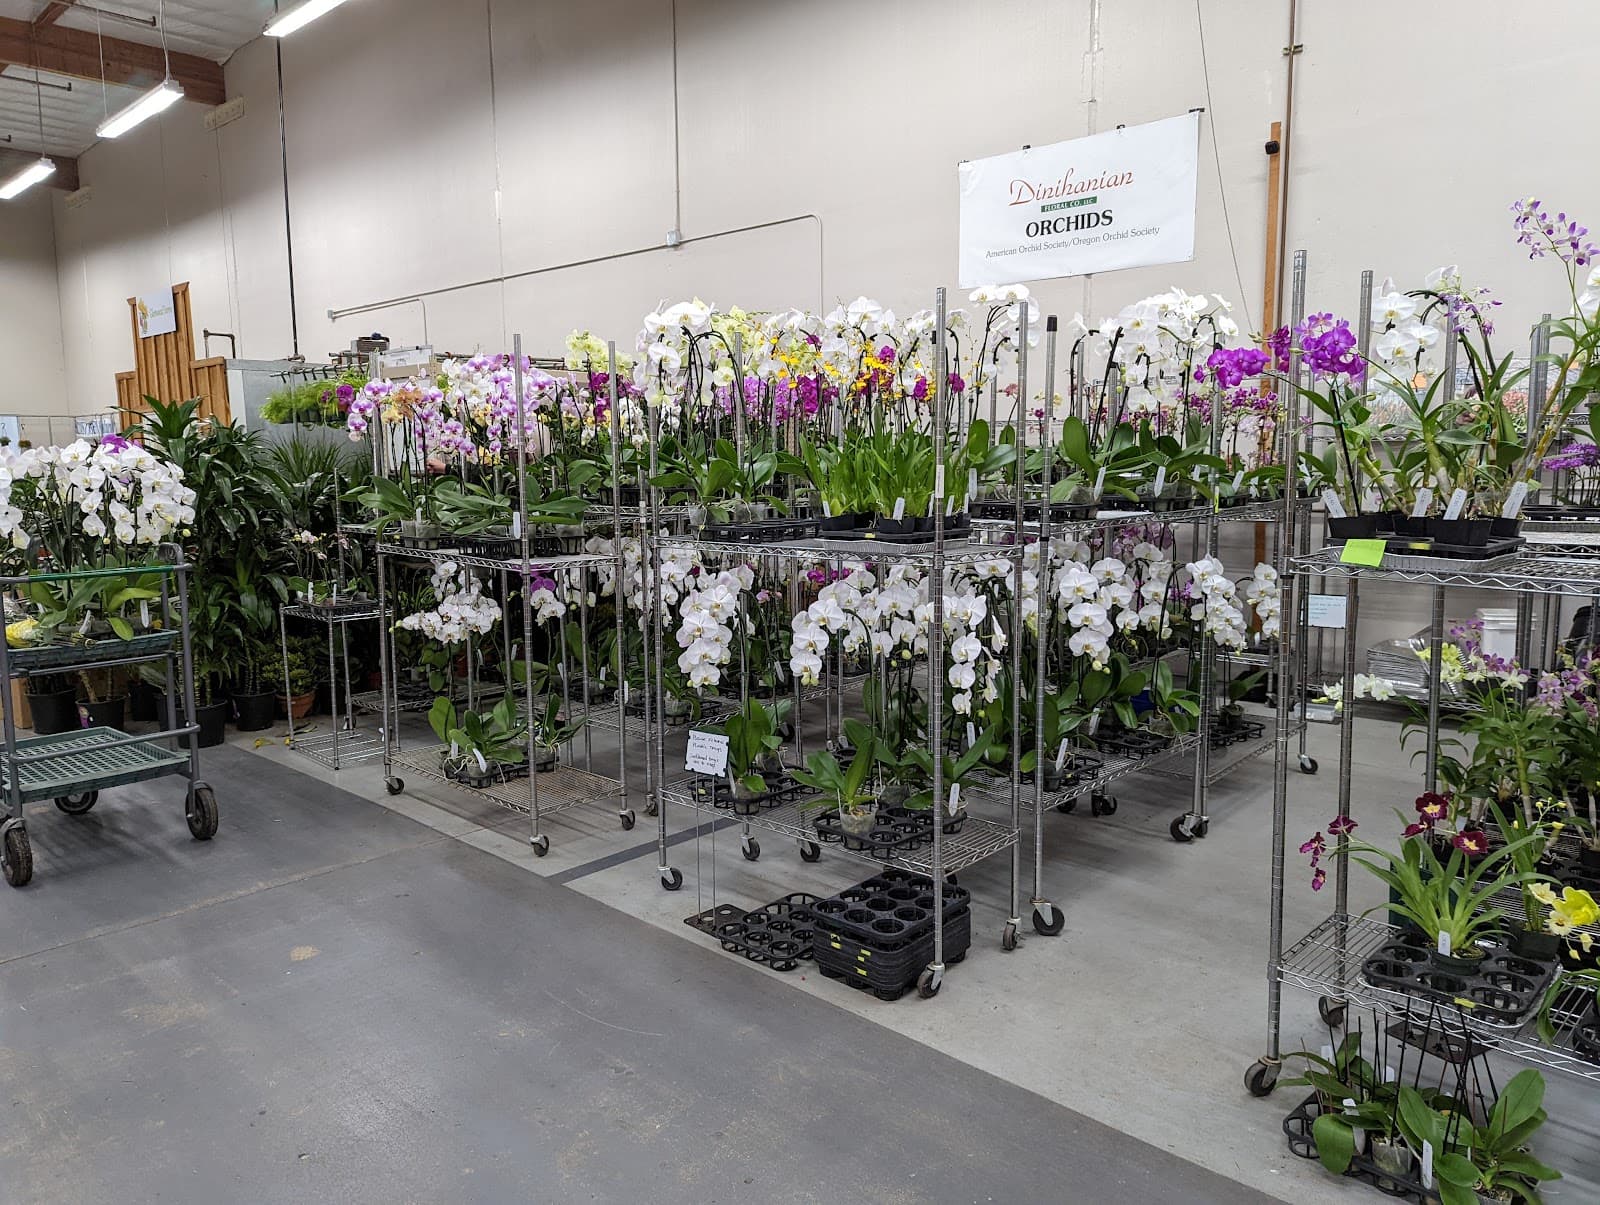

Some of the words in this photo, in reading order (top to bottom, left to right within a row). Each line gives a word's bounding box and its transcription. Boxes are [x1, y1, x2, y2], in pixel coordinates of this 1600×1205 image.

[1008, 168, 1133, 206] Dinihanian
[1044, 202, 1068, 212] FLORAL
[1026, 209, 1113, 238] ORCHIDS
[985, 247, 1017, 259] American
[1018, 242, 1042, 254] Orchid
[1102, 230, 1129, 242] Orchid
[1130, 226, 1160, 238] Society
